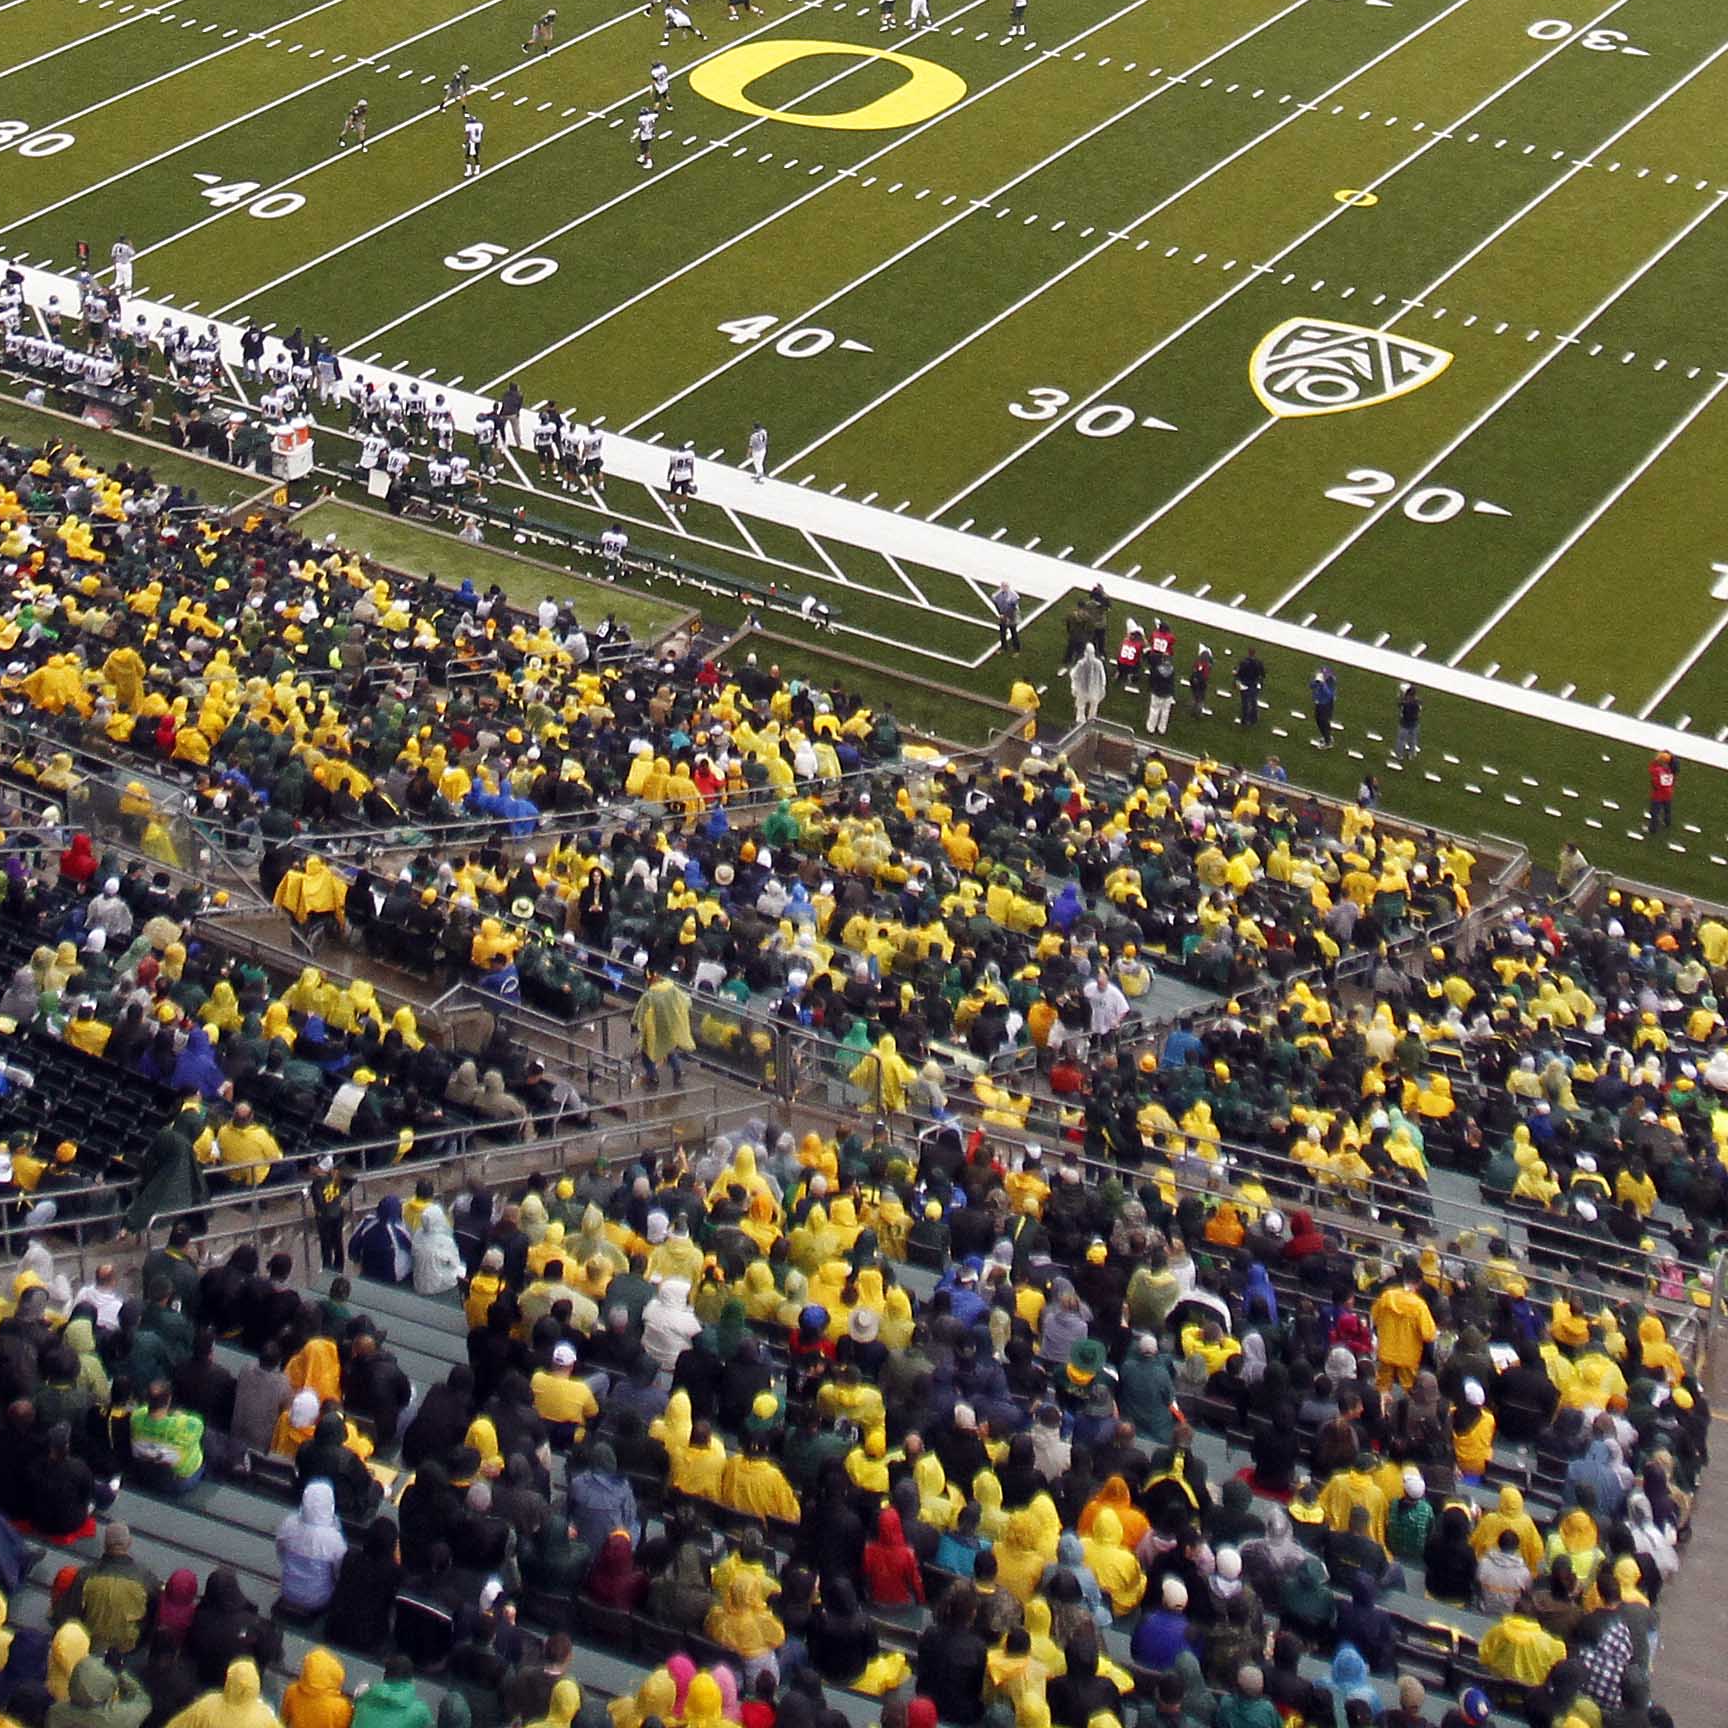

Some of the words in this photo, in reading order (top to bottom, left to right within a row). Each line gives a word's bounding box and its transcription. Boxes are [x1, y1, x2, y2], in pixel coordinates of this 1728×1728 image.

[1527, 18, 1631, 52] 30
[689, 40, 968, 130] O
[200, 181, 307, 219] 40
[444, 242, 559, 286] 50
[718, 315, 838, 358] 40
[1008, 387, 1135, 438] 30
[1324, 470, 1466, 523] 20
[1120, 645, 1137, 661] 66
